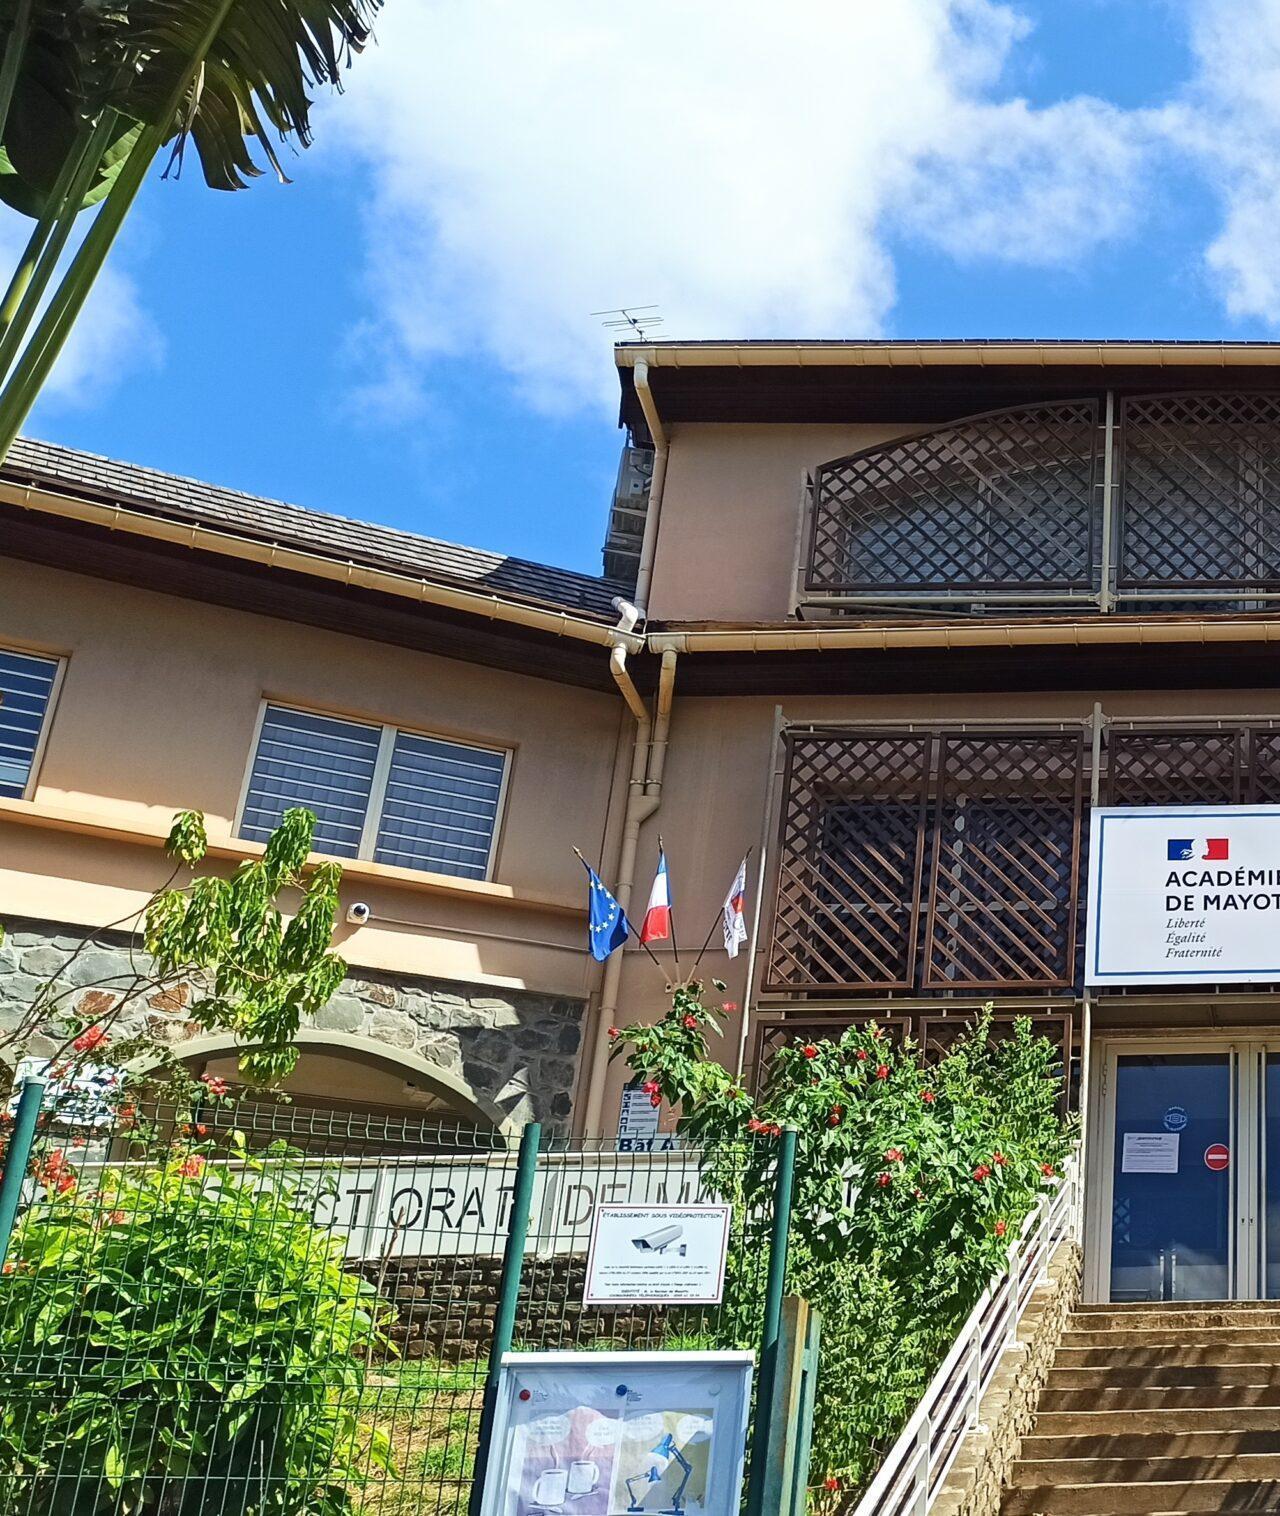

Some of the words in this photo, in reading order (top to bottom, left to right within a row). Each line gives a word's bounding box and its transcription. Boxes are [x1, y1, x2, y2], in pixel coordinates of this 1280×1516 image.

[1166, 895, 1194, 911] DE
[1166, 917, 1206, 929] Liberté
[1165, 931, 1207, 946] Égalité
[1165, 945, 1223, 958] Fraternité
